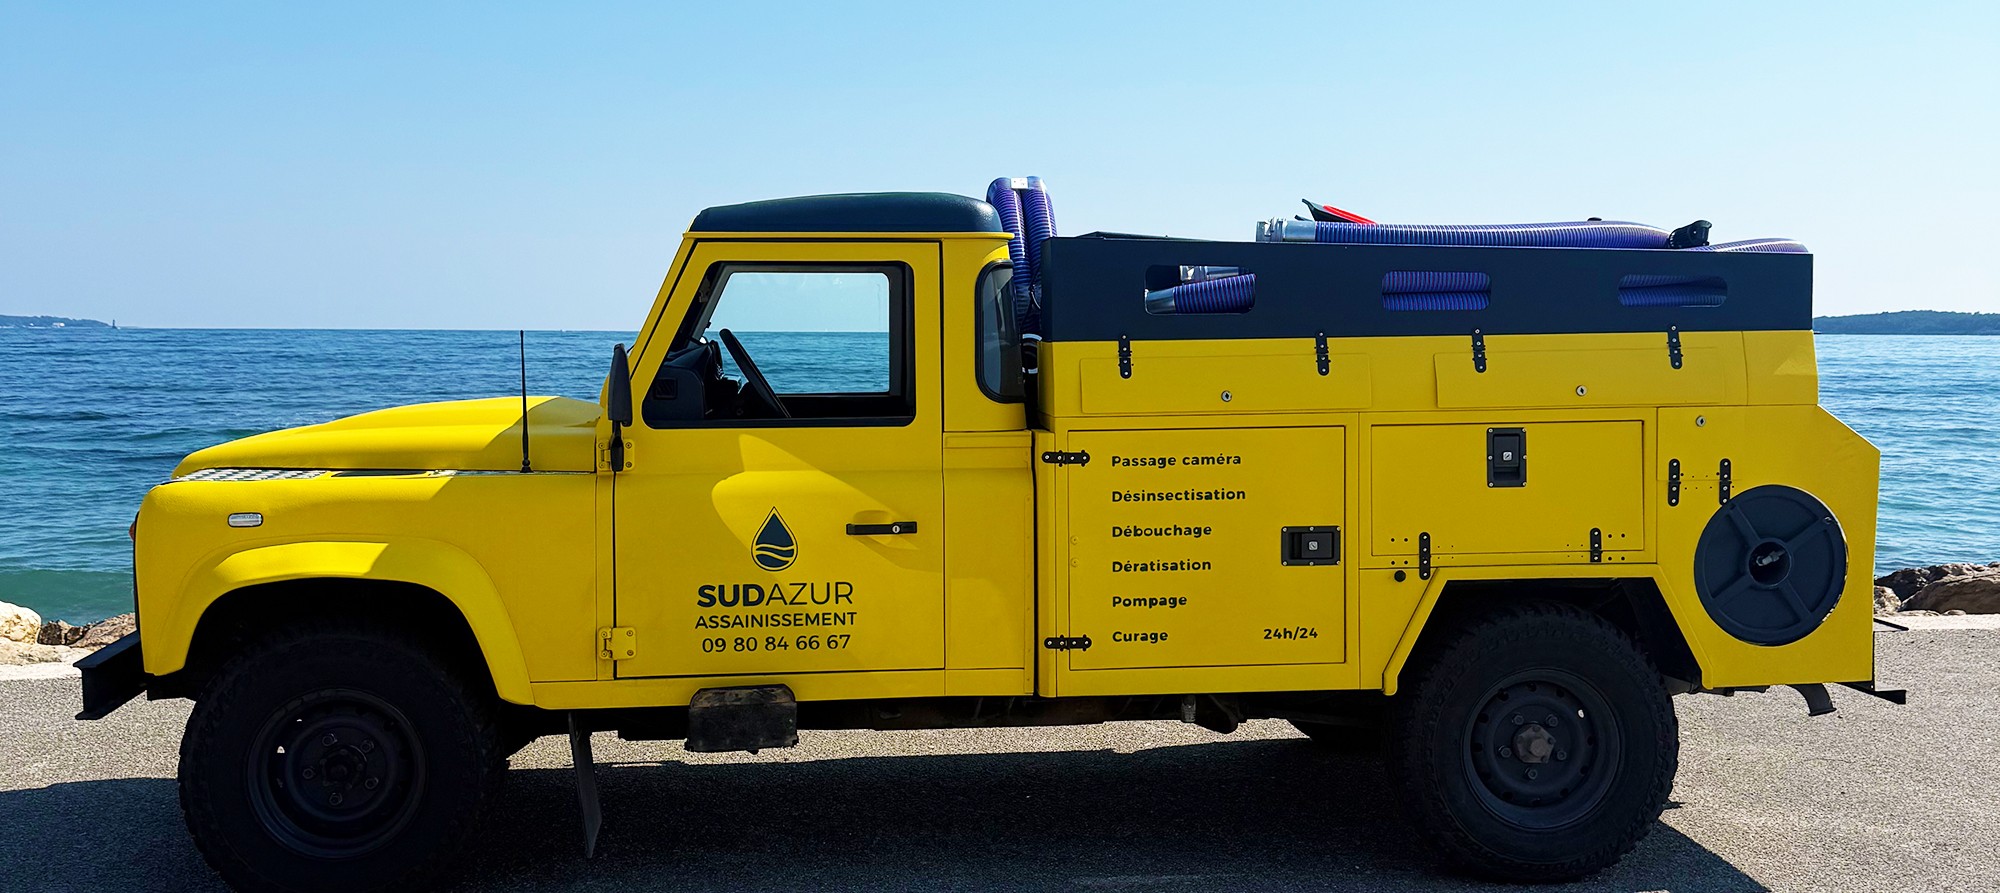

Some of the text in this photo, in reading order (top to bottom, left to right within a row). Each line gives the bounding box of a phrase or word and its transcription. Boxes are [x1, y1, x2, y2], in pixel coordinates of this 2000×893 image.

[1112, 452, 1242, 469] Passage caméra
[1112, 488, 1246, 502] Désinsectisation
[1112, 524, 1212, 538] Débouchage
[1112, 558, 1212, 573] Dératisation
[1112, 595, 1188, 609] Pompage
[695, 612, 857, 629] ASSAINISSEMENT
[1112, 630, 1169, 645] Curage
[1263, 626, 1319, 641] 24h/24
[702, 634, 851, 653] 09 80 84 66 67
